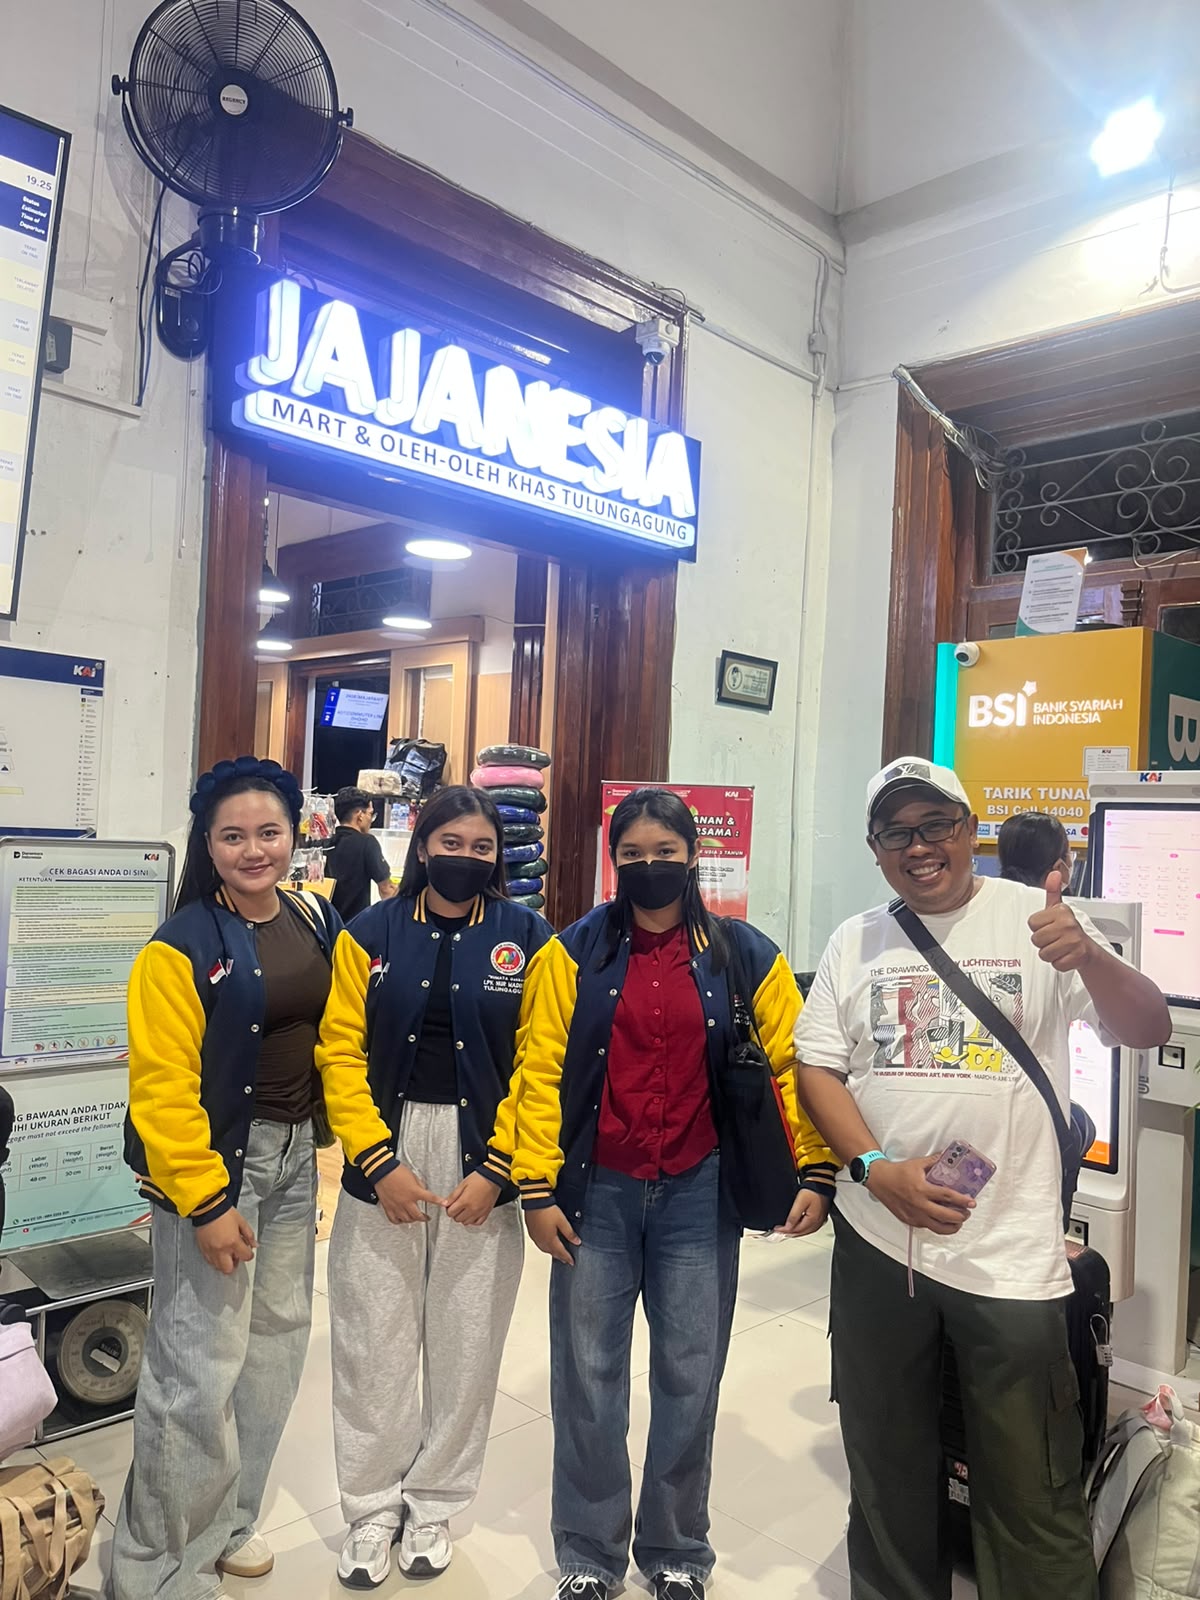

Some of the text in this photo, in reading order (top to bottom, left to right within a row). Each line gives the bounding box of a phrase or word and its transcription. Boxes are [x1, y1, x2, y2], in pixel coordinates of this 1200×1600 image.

[26, 175, 52, 191] 19.25
[246, 278, 696, 519] JAJANESIA
[272, 398, 688, 541] MART & OLEH-OLEH KHAS TULUNGAGUNG
[968, 692, 1027, 728] BSI
[1033, 698, 1124, 714] BANK SYARIAH
[1033, 712, 1102, 725] INDONESIA
[983, 787, 1032, 800] TARIK
[987, 805, 1083, 817] BSI Call 14040
[693, 816, 735, 825] ANAN &
[696, 828, 732, 837] RSAMA
[870, 967, 884, 976] THE
[886, 964, 929, 974] DRAWINGS
[962, 959, 1022, 967] LICHTENSTEIN
[483, 986, 522, 994] TULUNGAGU
[26, 1108, 68, 1121] BAWAAN
[71, 1105, 97, 1114] ANDA
[100, 1101, 126, 1111] TIDAK
[30, 1117, 71, 1130] UKURAN
[74, 1112, 111, 1124] BERIKUT
[27, 1132, 44, 1140] must
[58, 1127, 80, 1135] exceed
[92, 1122, 121, 1132] following
